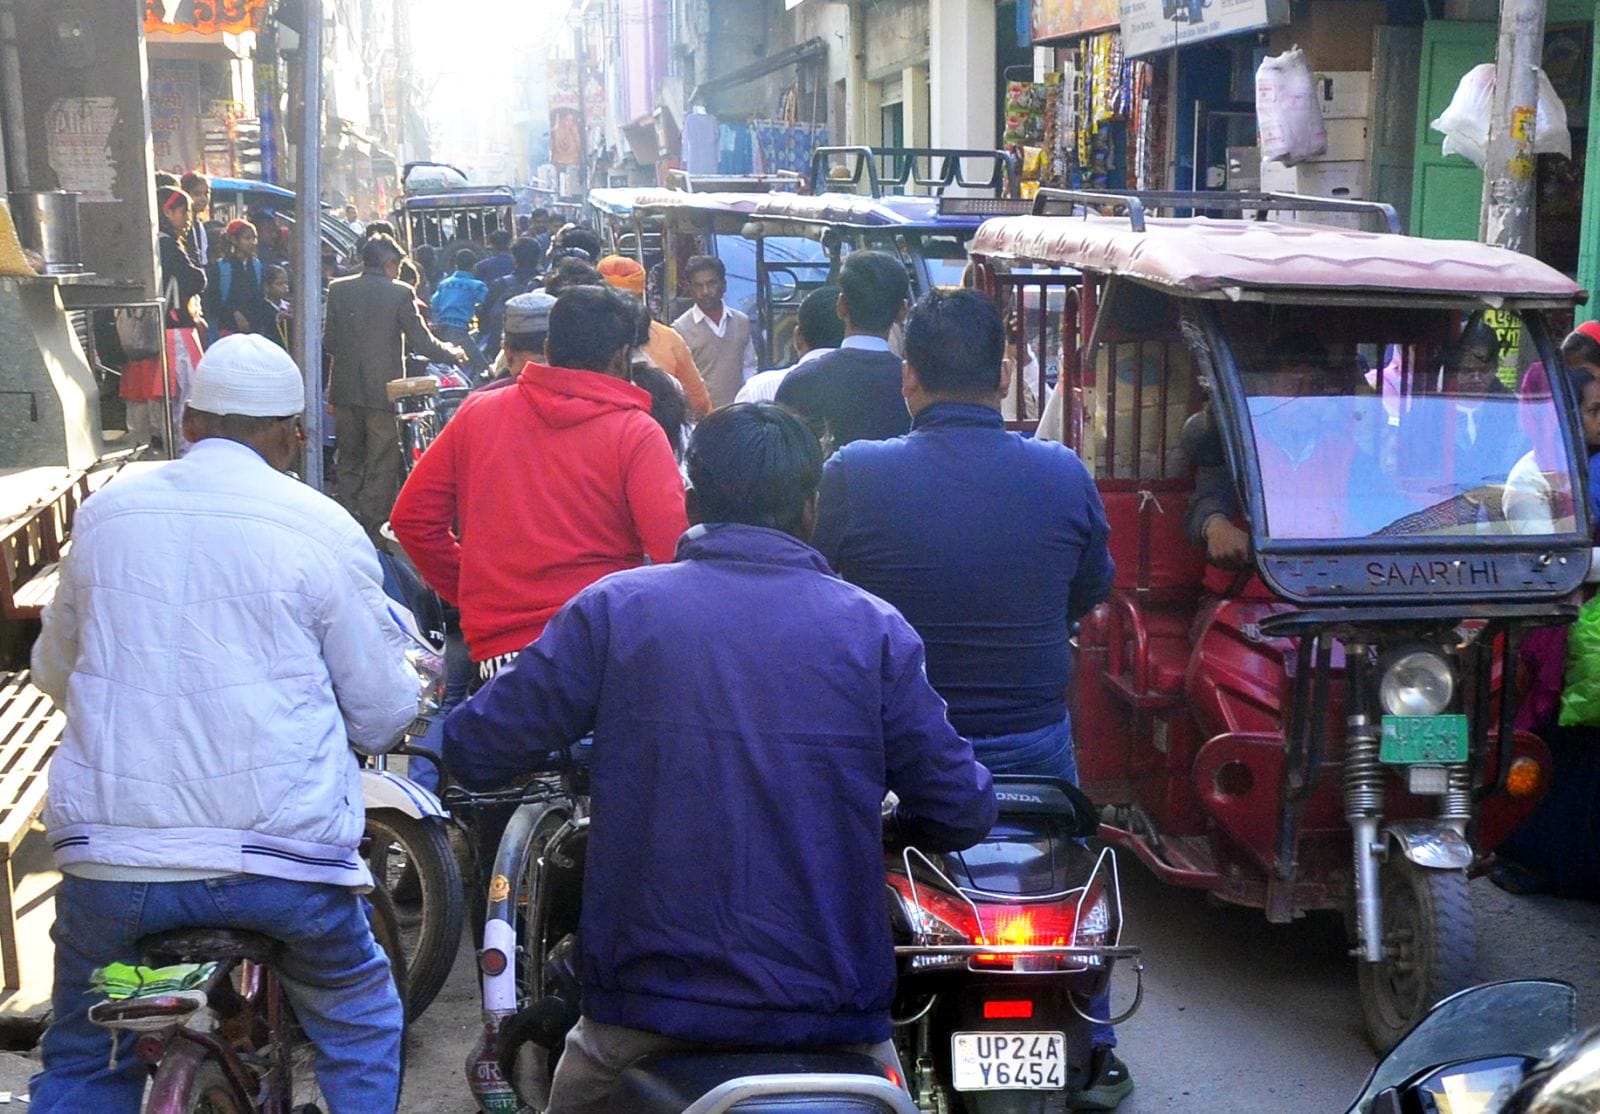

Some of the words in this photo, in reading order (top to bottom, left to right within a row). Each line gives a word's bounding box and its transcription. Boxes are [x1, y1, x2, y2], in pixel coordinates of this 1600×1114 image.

[1366, 560, 1499, 586] SAARTHI
[995, 792, 1043, 803] ONDA
[977, 1036, 1058, 1060] UP24A
[979, 1062, 1060, 1086] Y6454
